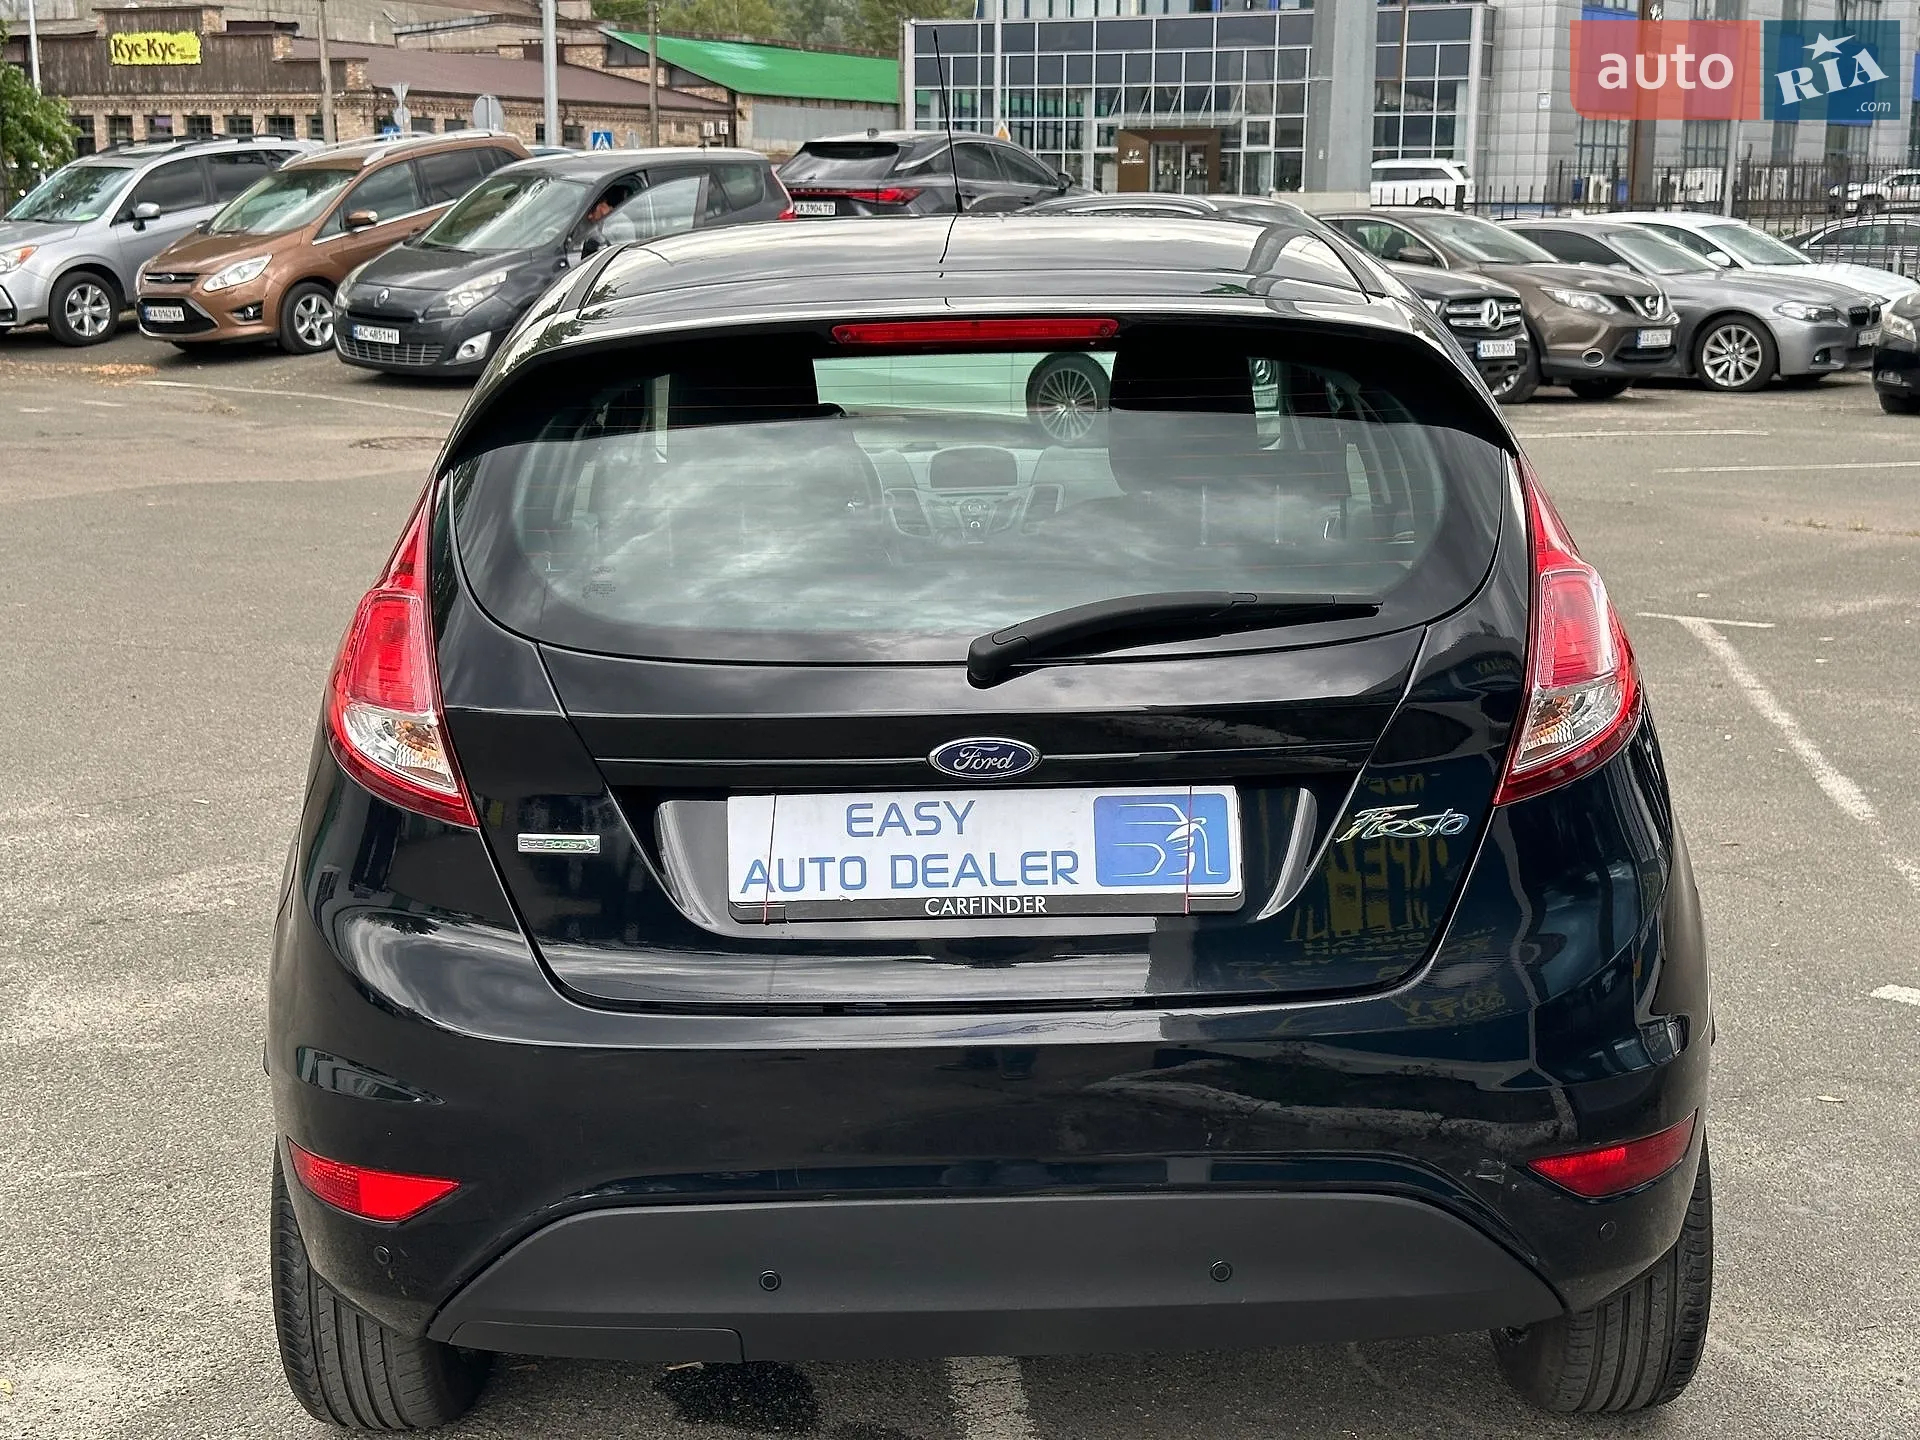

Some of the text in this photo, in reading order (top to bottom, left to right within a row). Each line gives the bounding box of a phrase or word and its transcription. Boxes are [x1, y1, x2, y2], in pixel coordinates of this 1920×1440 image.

[953, 746, 1015, 770] Ford
[846, 799, 976, 838] EASY
[1336, 804, 1470, 843] Fiesta
[740, 850, 1079, 894] AUTO DEALER
[925, 896, 1048, 916] CARFINDER
